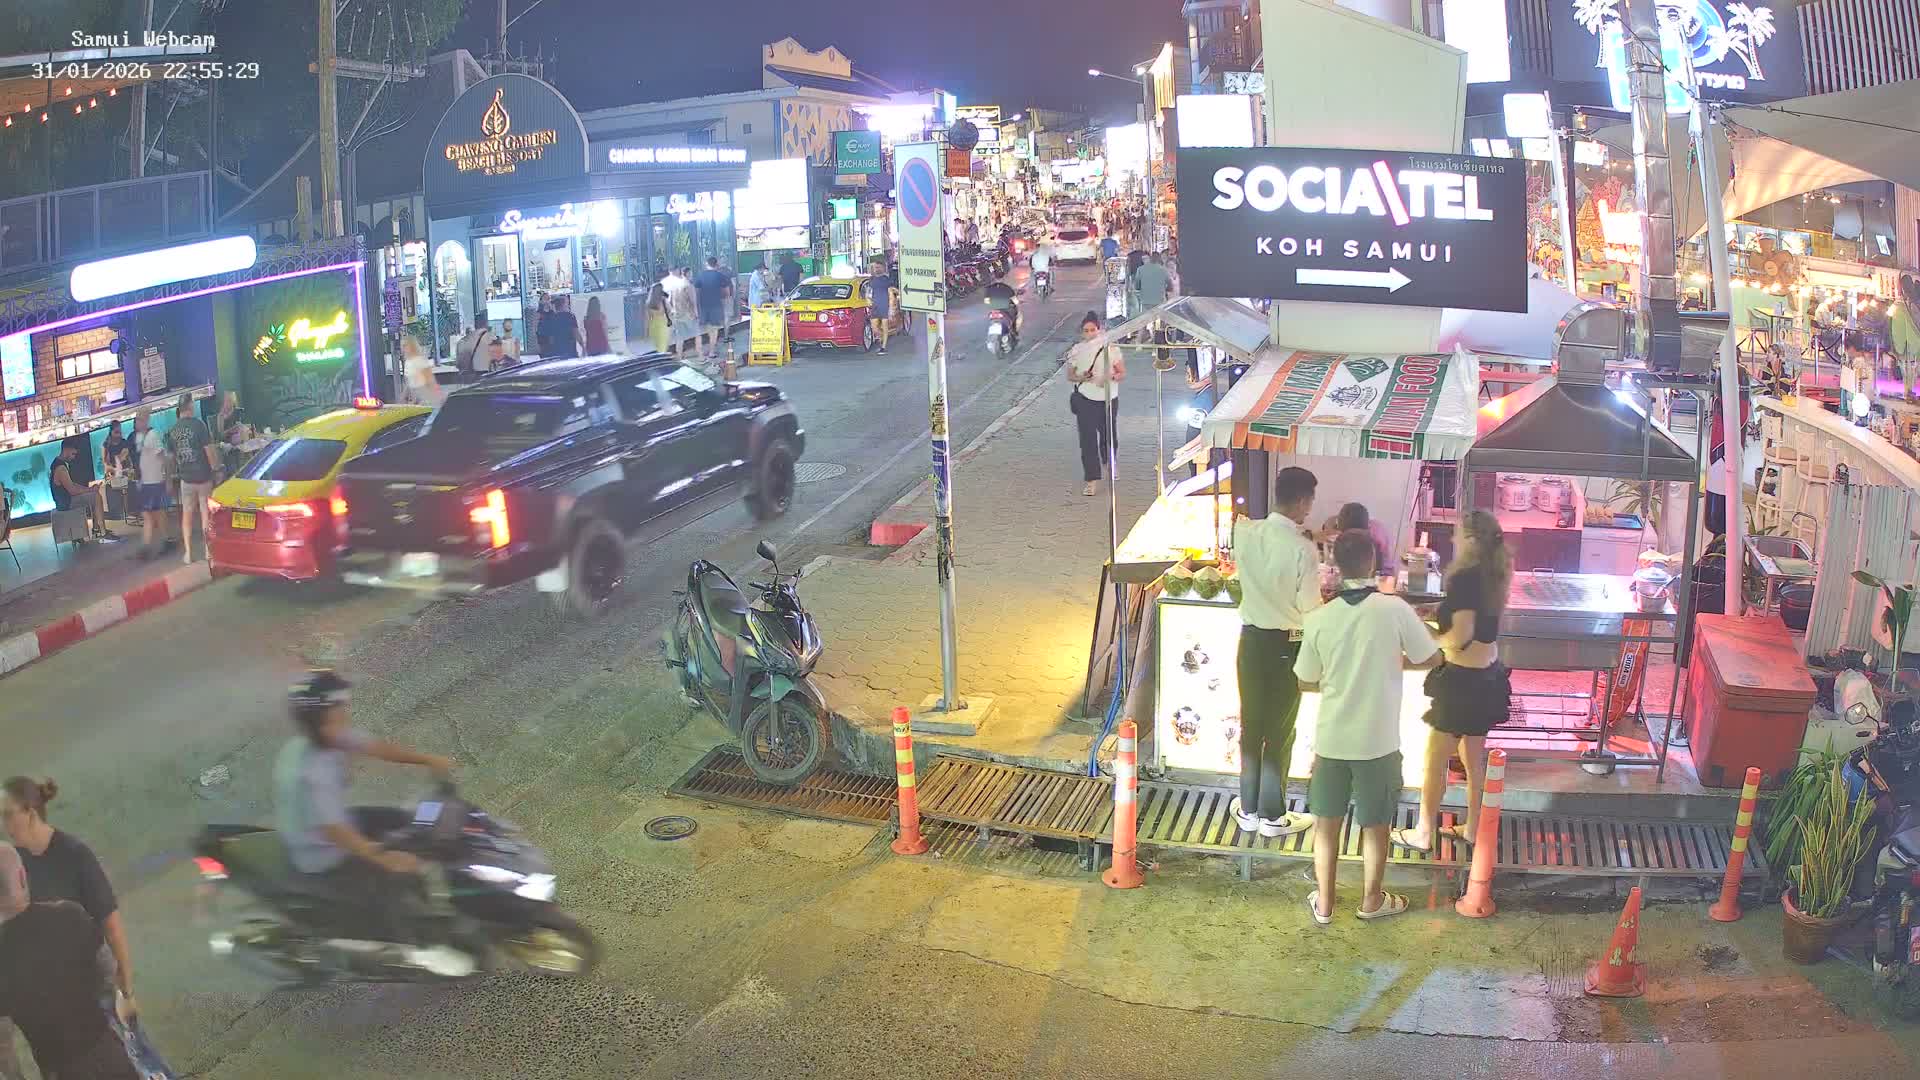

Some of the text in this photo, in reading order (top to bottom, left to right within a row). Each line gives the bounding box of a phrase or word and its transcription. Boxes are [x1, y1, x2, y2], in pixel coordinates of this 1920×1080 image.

[838, 159, 878, 168] EXCHANGE
[1256, 236, 1451, 263] KOH SAMUI
[905, 267, 937, 278] NO PARKING
[1394, 355, 1442, 395] FOOD
